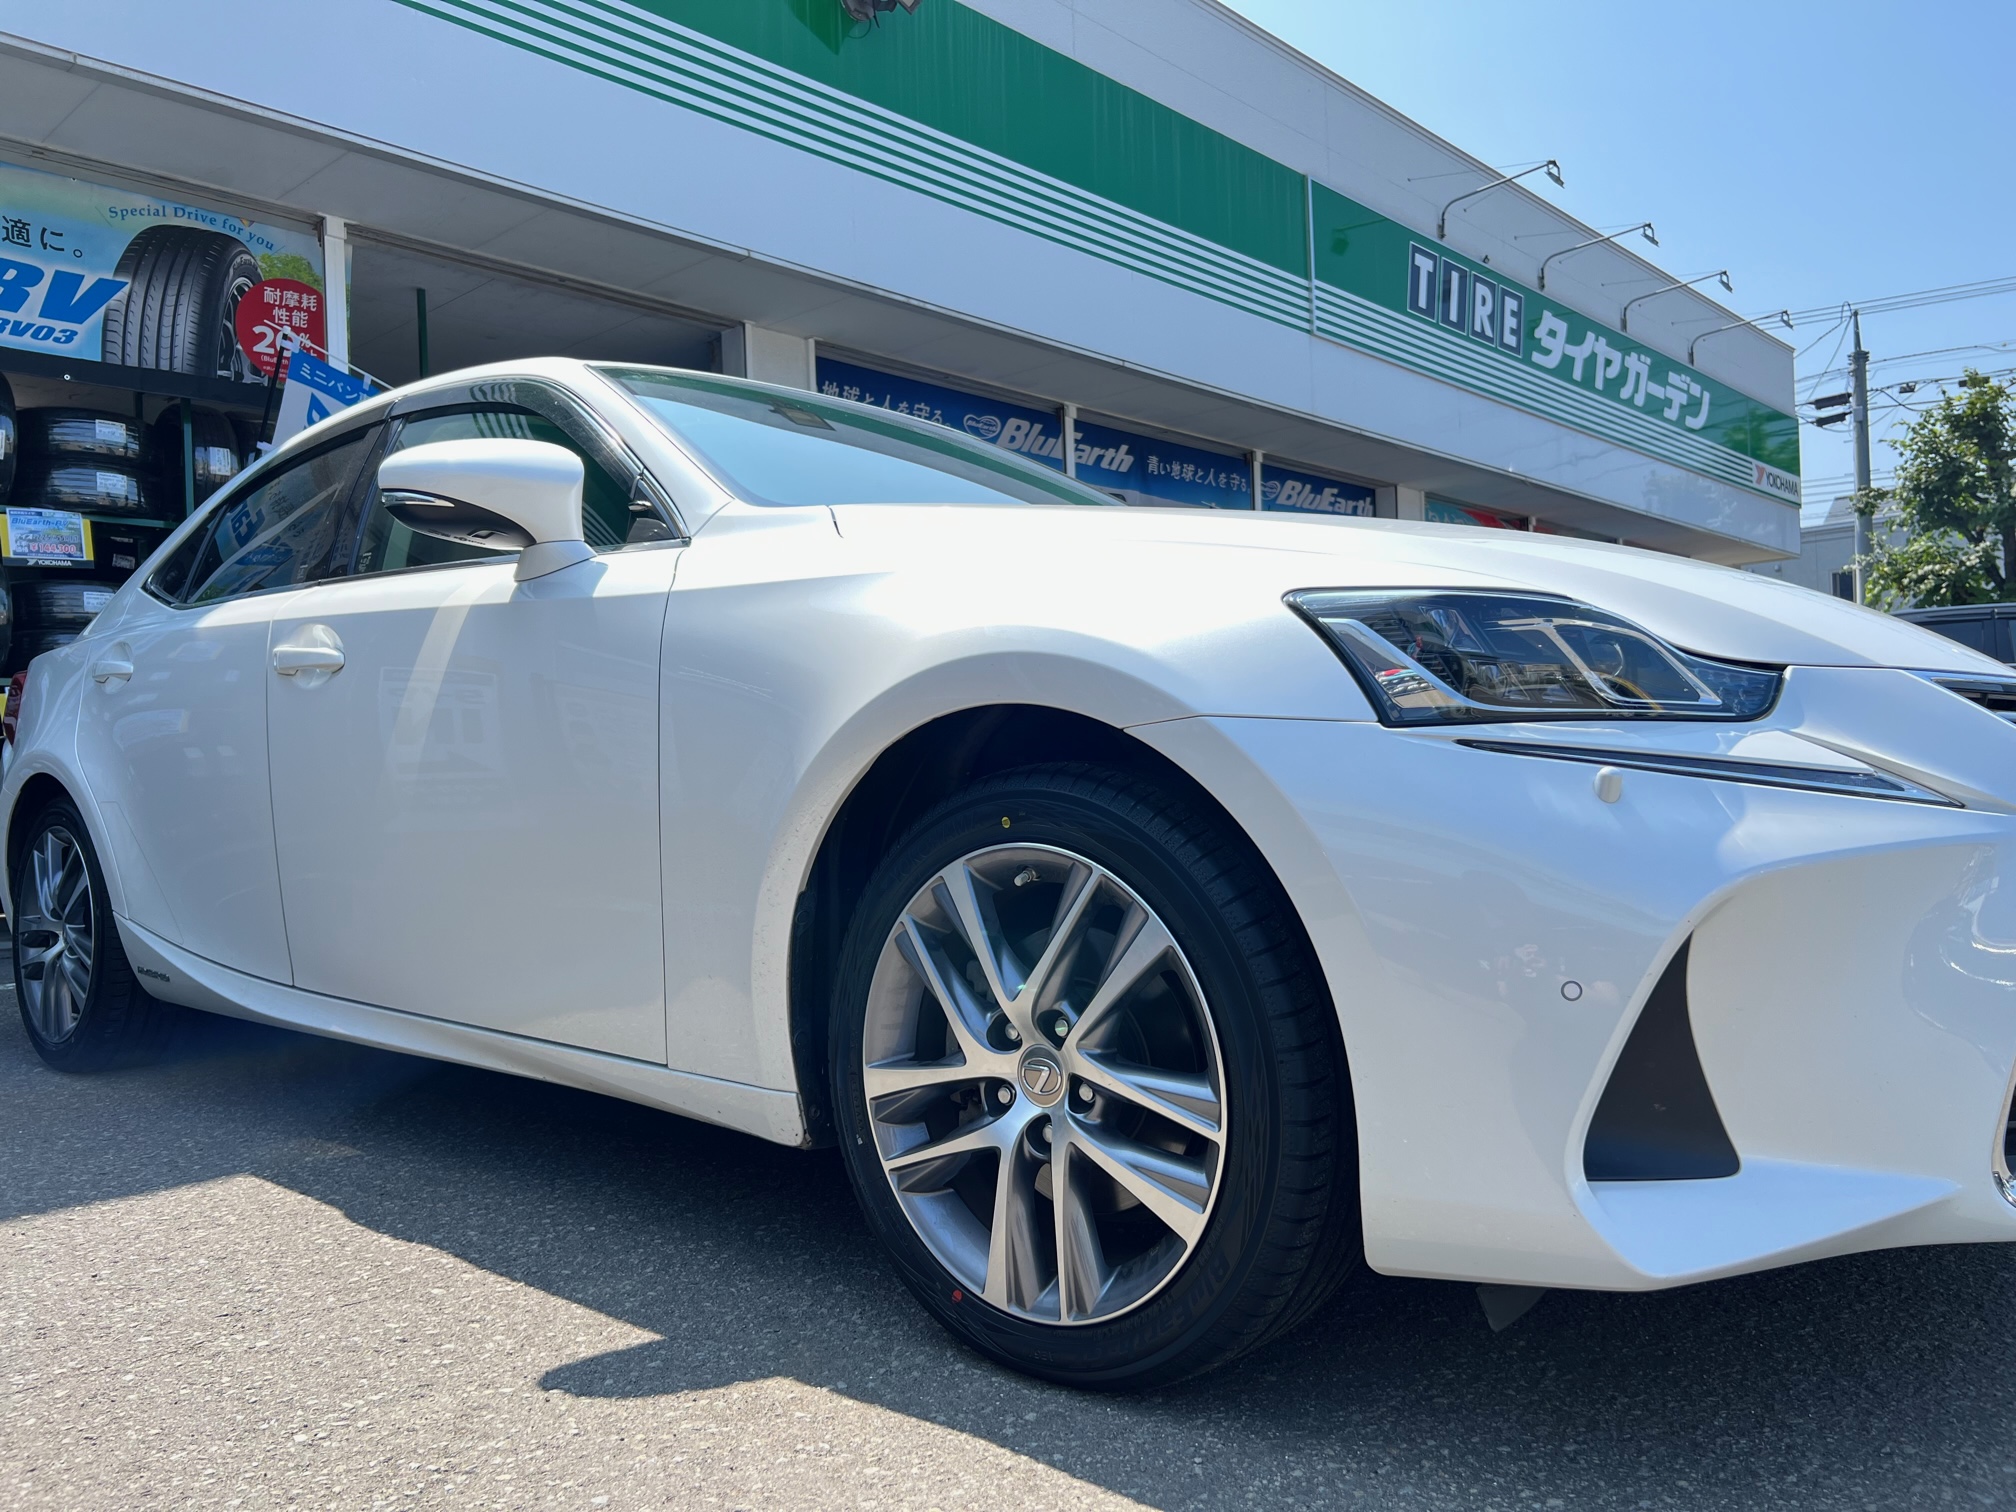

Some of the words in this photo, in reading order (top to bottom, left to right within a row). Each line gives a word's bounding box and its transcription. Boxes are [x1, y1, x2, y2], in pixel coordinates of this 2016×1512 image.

[109, 205, 167, 220] Special
[173, 206, 217, 226] Drive
[222, 218, 244, 236] for
[246, 231, 275, 251] you
[263, 286, 317, 312] 耐摩耗
[272, 306, 308, 328] 性能
[1413, 252, 1519, 348] TIRE
[1531, 309, 1710, 431] タイヤガーデン
[1275, 479, 1374, 517] BluEarth
[1765, 469, 1799, 497] YOKOHAMA
